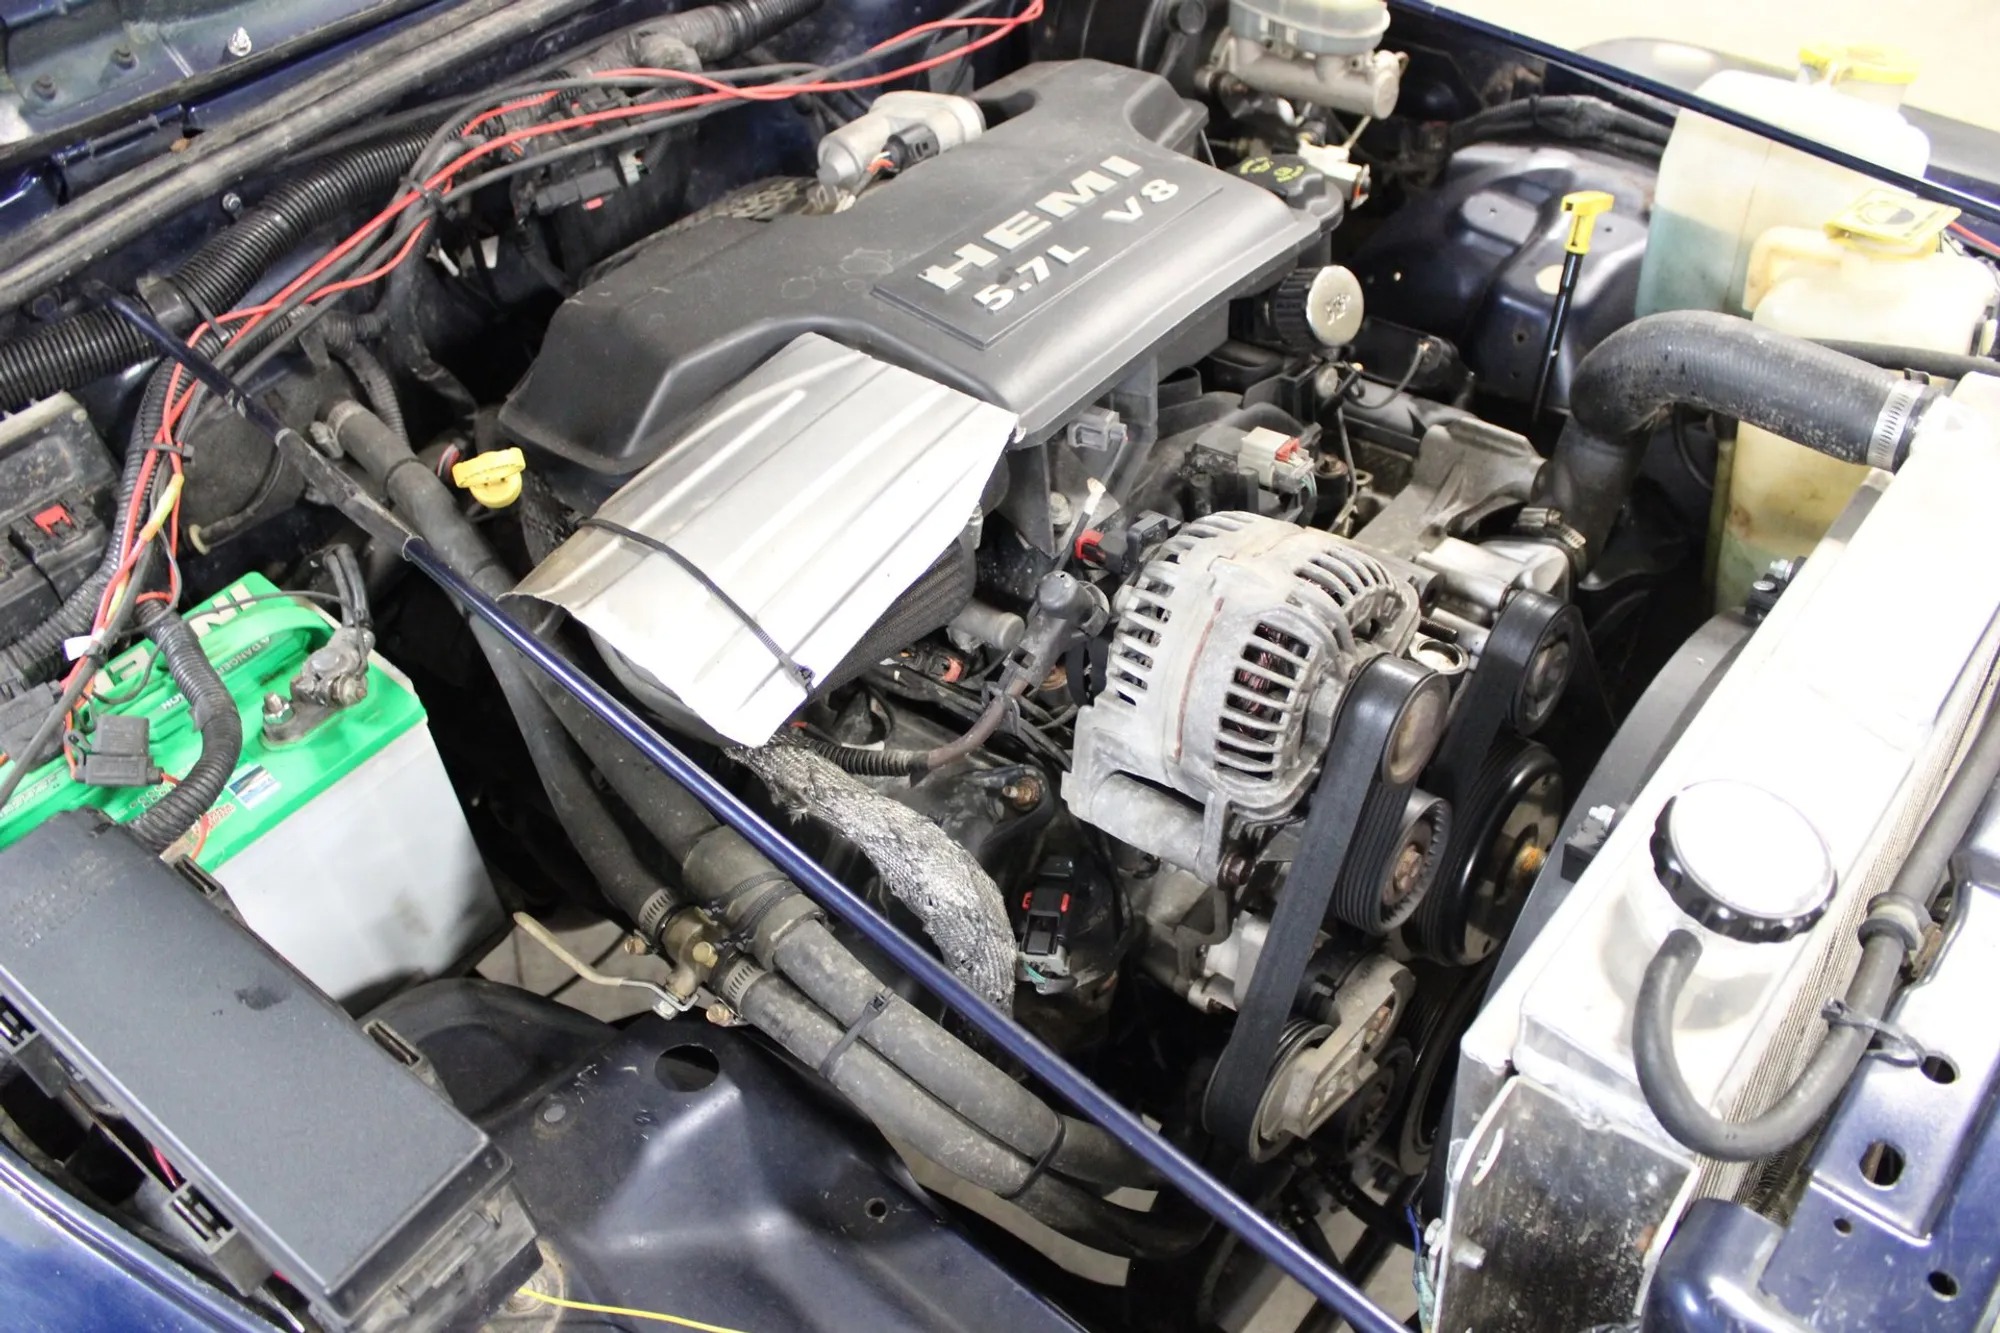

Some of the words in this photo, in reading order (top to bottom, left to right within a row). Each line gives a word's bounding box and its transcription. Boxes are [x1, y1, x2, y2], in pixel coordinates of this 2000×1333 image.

[917, 155, 1142, 292] HEMI
[972, 244, 1091, 314] 5.7L
[1102, 178, 1180, 223] V8
